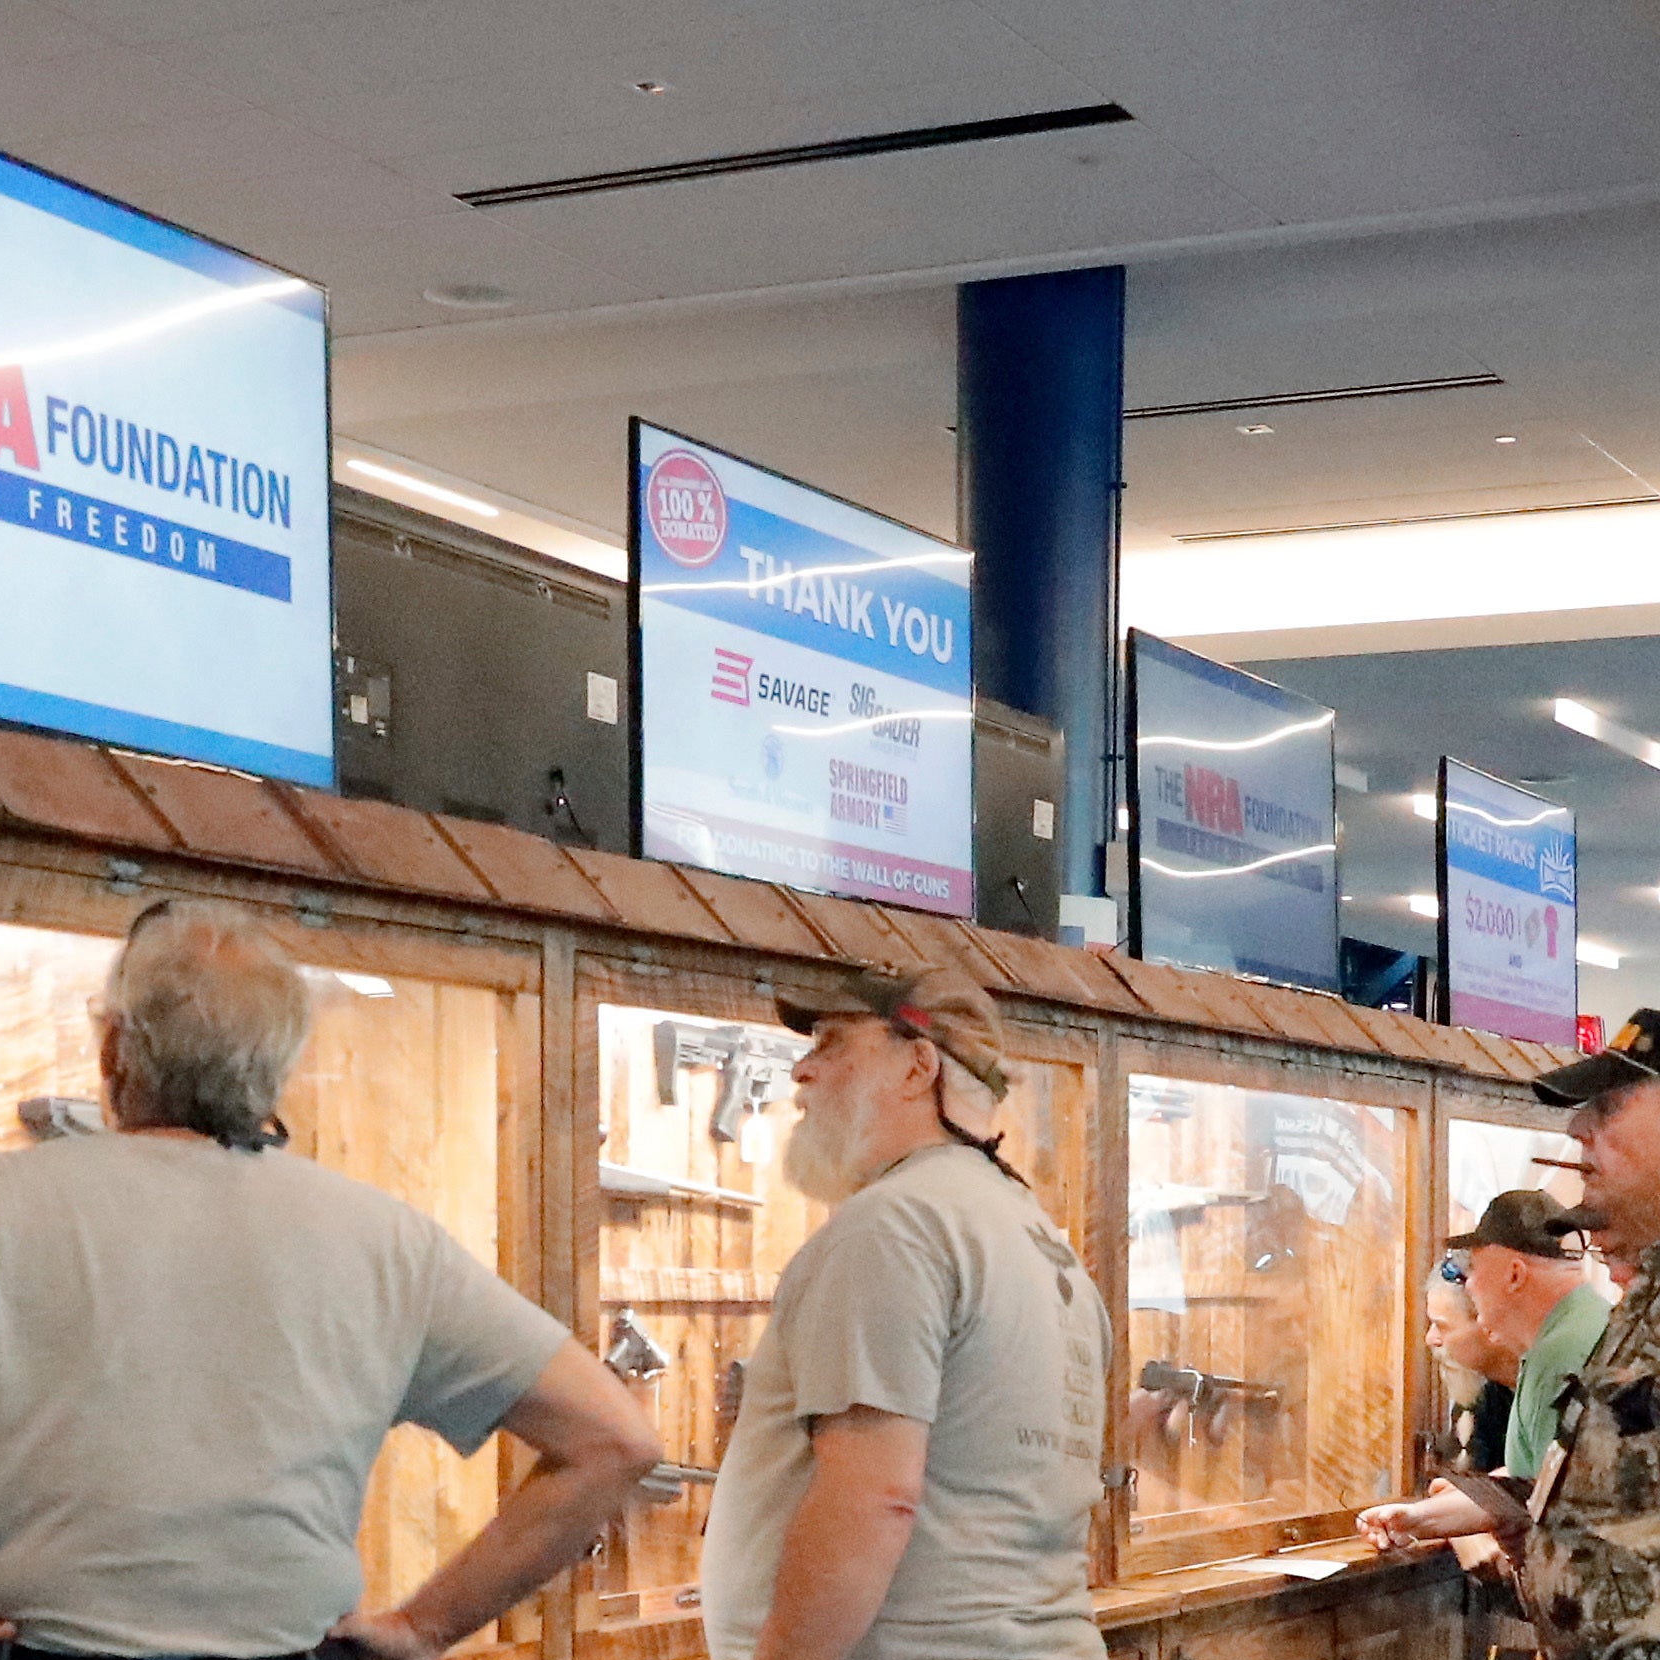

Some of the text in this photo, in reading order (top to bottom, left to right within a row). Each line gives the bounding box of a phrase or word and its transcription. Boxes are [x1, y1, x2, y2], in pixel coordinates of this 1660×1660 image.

[46, 395, 292, 530] FOUNDATION
[657, 487, 717, 524] 100 %
[27, 488, 220, 573] FREEDOM
[740, 545, 954, 665] THANK YOU
[758, 673, 831, 718] SAVAGE
[849, 682, 877, 720] SIG
[828, 757, 909, 806] SPRINGFIELD
[1154, 764, 1184, 808] THE
[1183, 764, 1245, 837] NRA
[830, 791, 881, 830] ARMORY
[818, 851, 850, 878] THE
[851, 860, 891, 889] WALL
[892, 869, 913, 892] OF
[912, 874, 951, 900] GUNS
